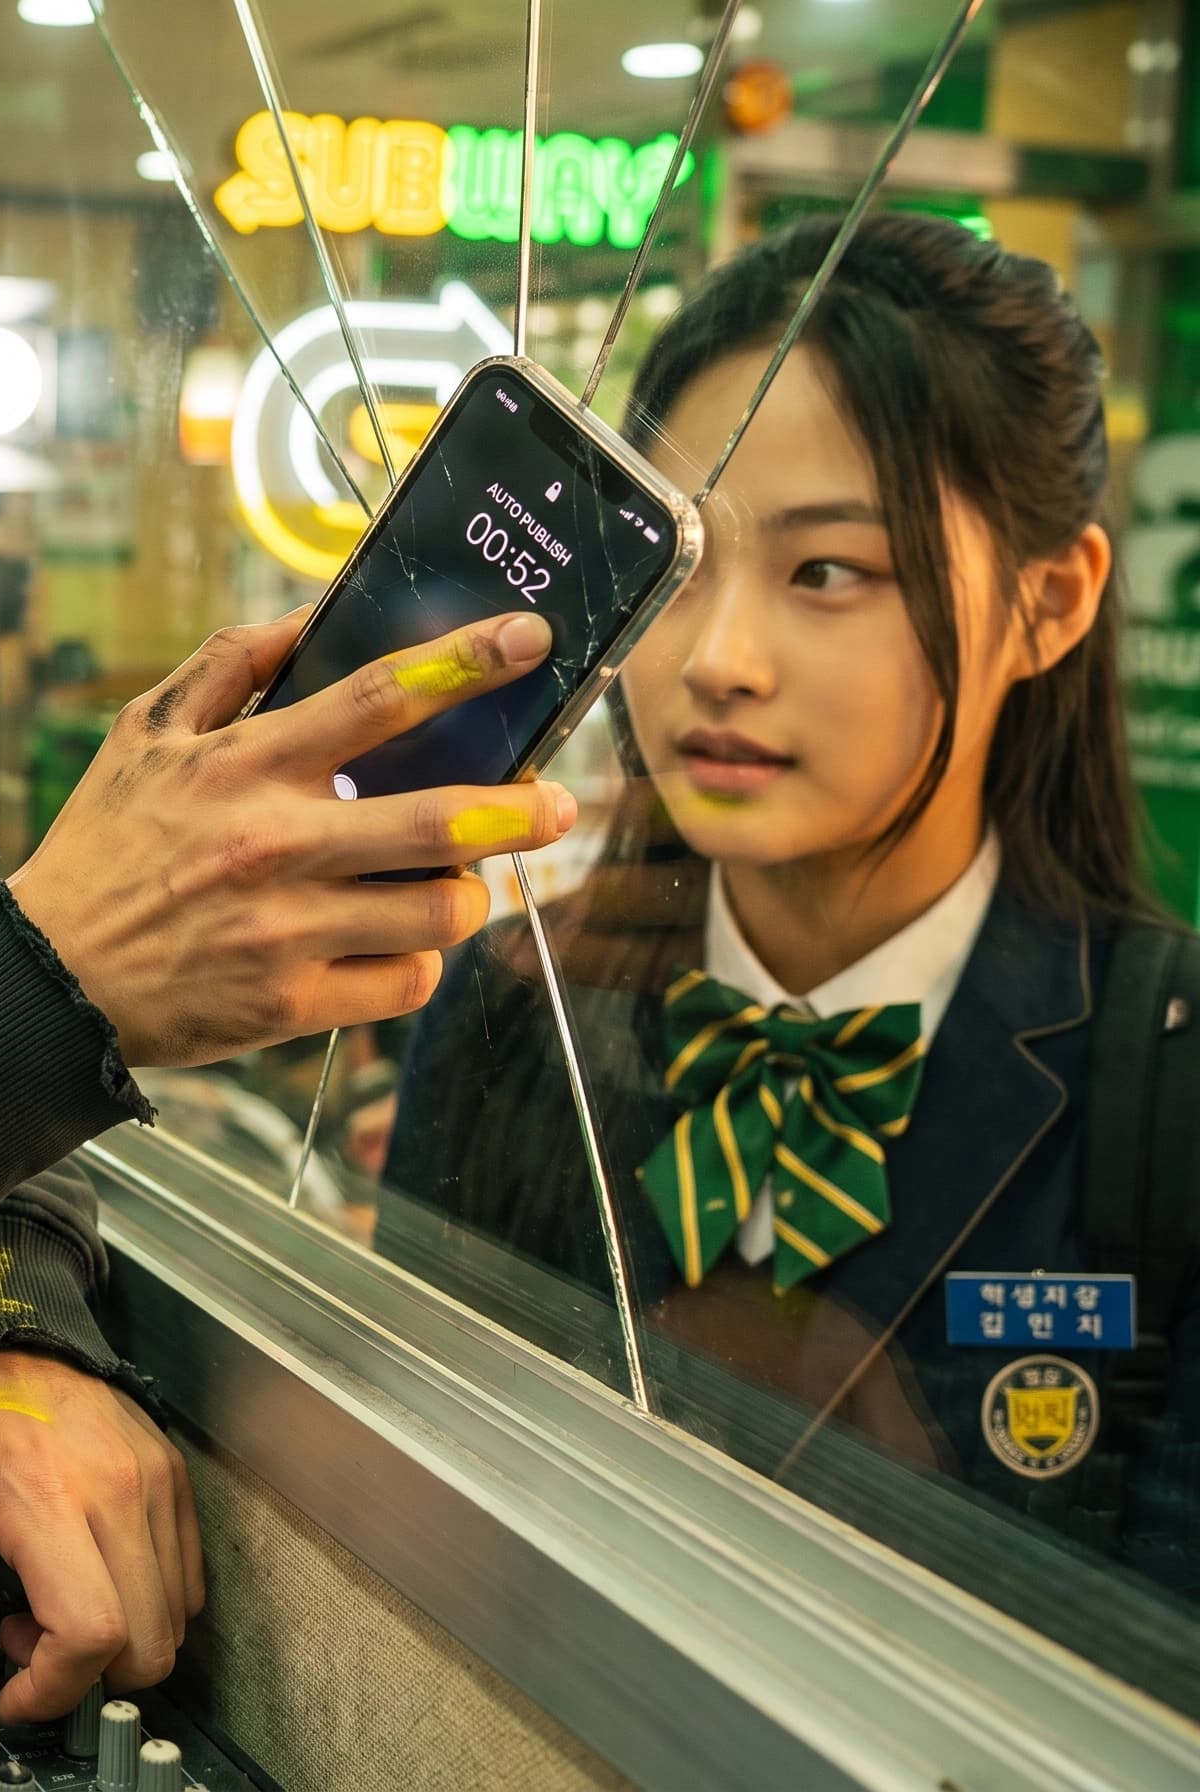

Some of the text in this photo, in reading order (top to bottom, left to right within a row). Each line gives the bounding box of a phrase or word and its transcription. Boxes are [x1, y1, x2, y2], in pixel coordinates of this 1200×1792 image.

[214, 111, 695, 249] SUBWAY
[465, 511, 552, 605] 00:52
[486, 482, 574, 568] AUTO PUBLISH
